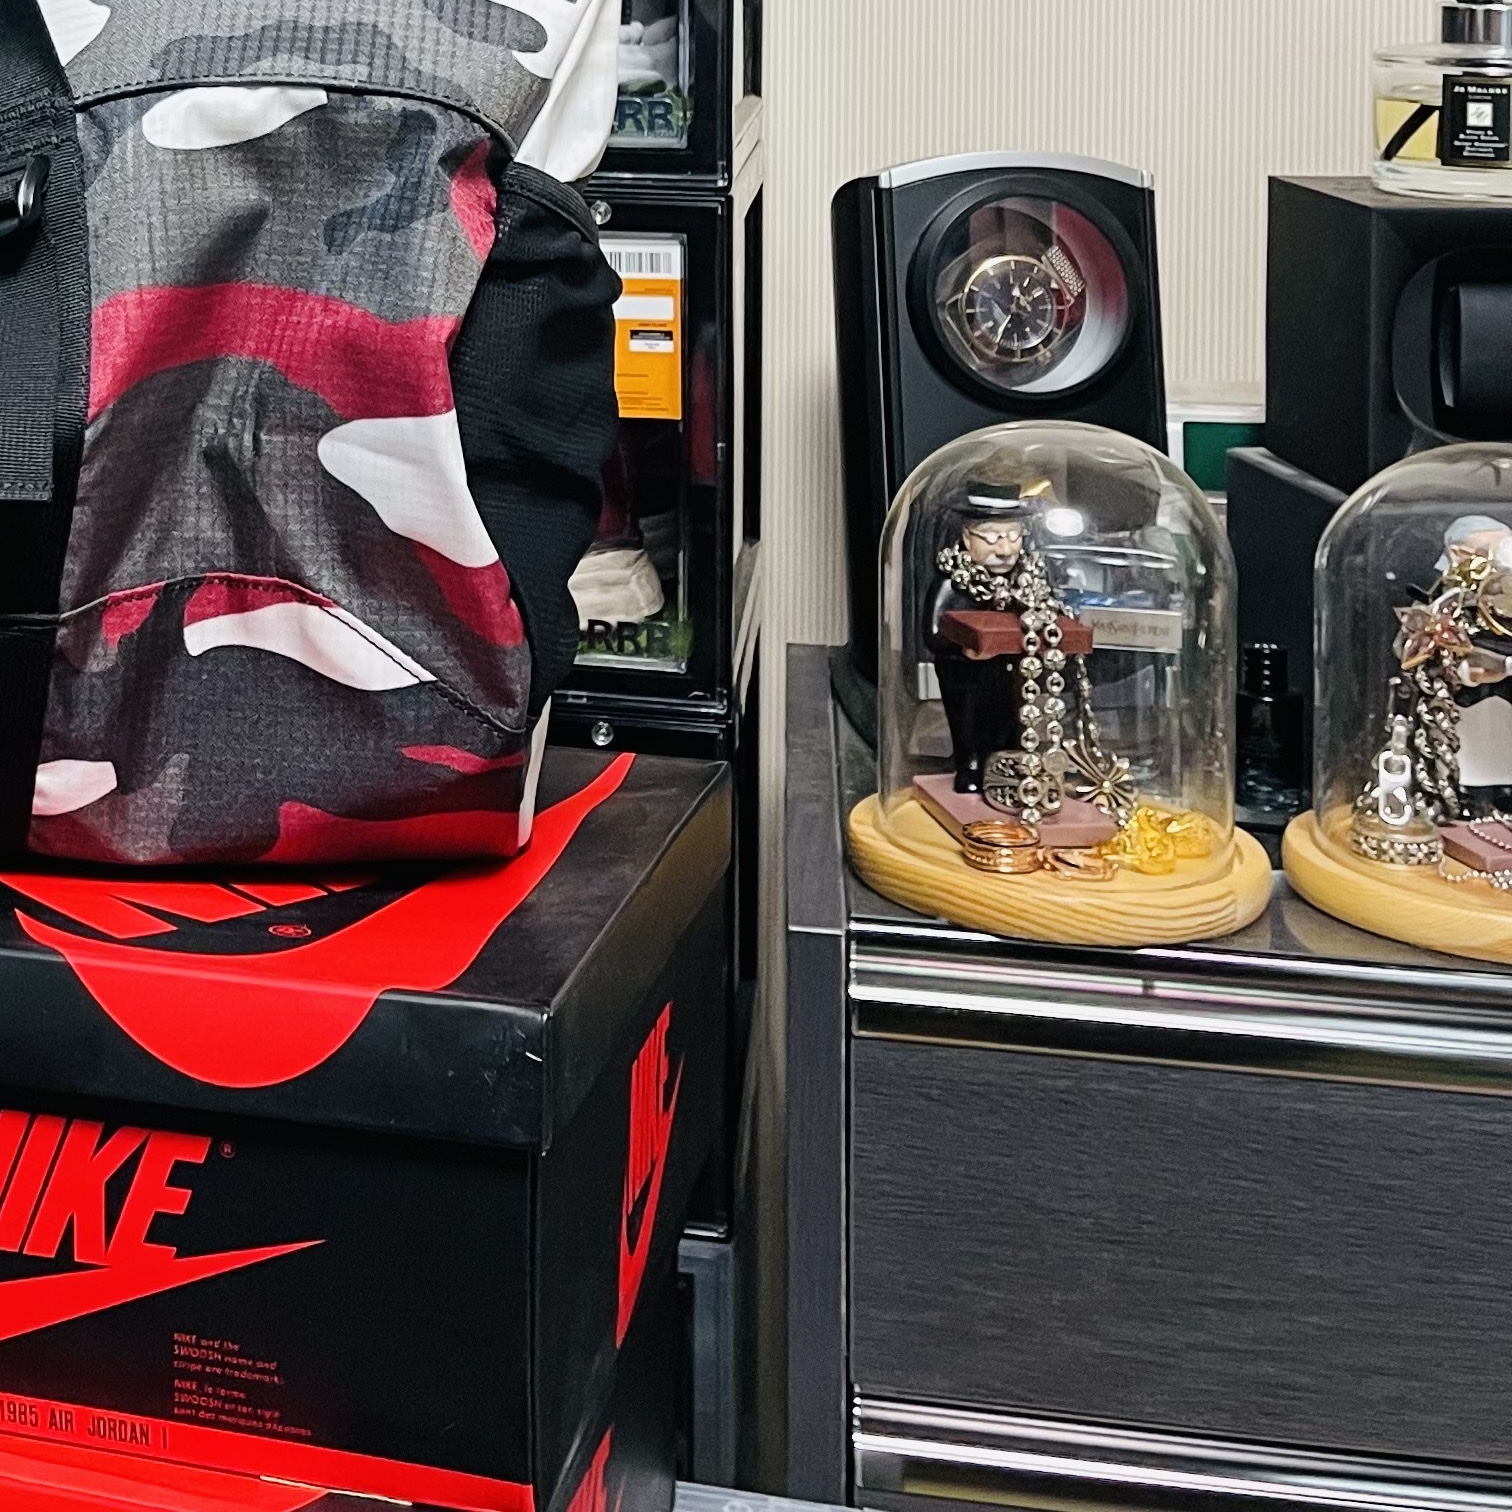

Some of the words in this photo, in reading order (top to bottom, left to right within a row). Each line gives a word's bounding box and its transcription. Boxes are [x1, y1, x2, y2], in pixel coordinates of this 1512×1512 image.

[615, 99, 675, 132] RR
[48, 1406, 74, 1434] AIR
[87, 1414, 151, 1448] JORDAN
